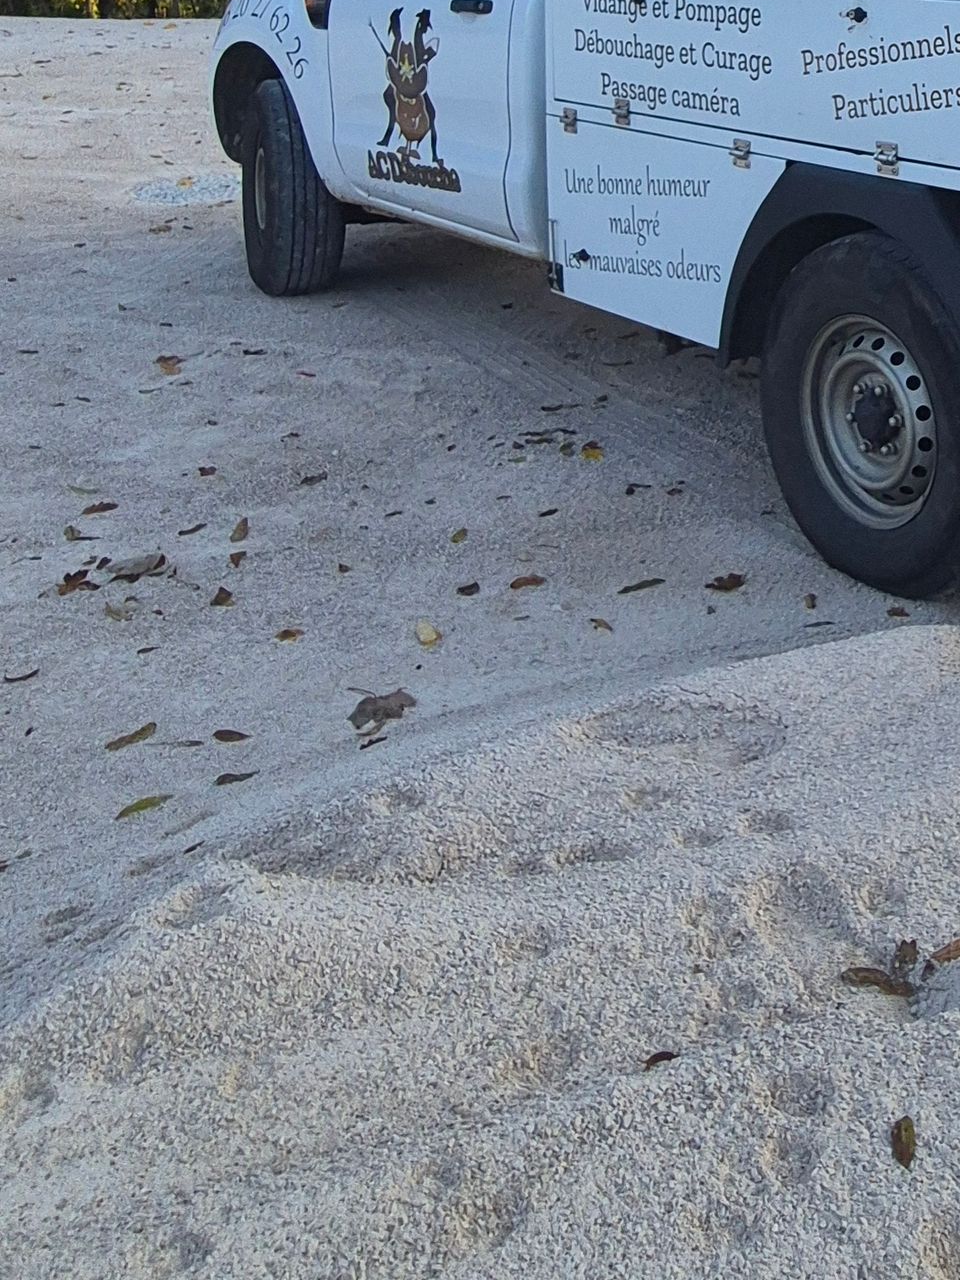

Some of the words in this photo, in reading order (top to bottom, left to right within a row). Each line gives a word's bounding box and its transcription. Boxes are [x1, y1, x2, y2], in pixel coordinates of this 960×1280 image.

[269, 4, 291, 44] 62
[285, 35, 311, 80] 26
[573, 28, 675, 69] Débouchage
[679, 42, 698, 66] et
[702, 42, 773, 81] Curage
[601, 72, 668, 111] Passage
[671, 87, 741, 117] caméra
[564, 167, 594, 195] Une
[597, 164, 643, 196] bonne
[646, 164, 711, 198] humeur
[608, 204, 661, 247] malgré
[563, 239, 582, 270] les
[588, 249, 663, 278] mauvaises
[666, 247, 722, 284] odeurs
